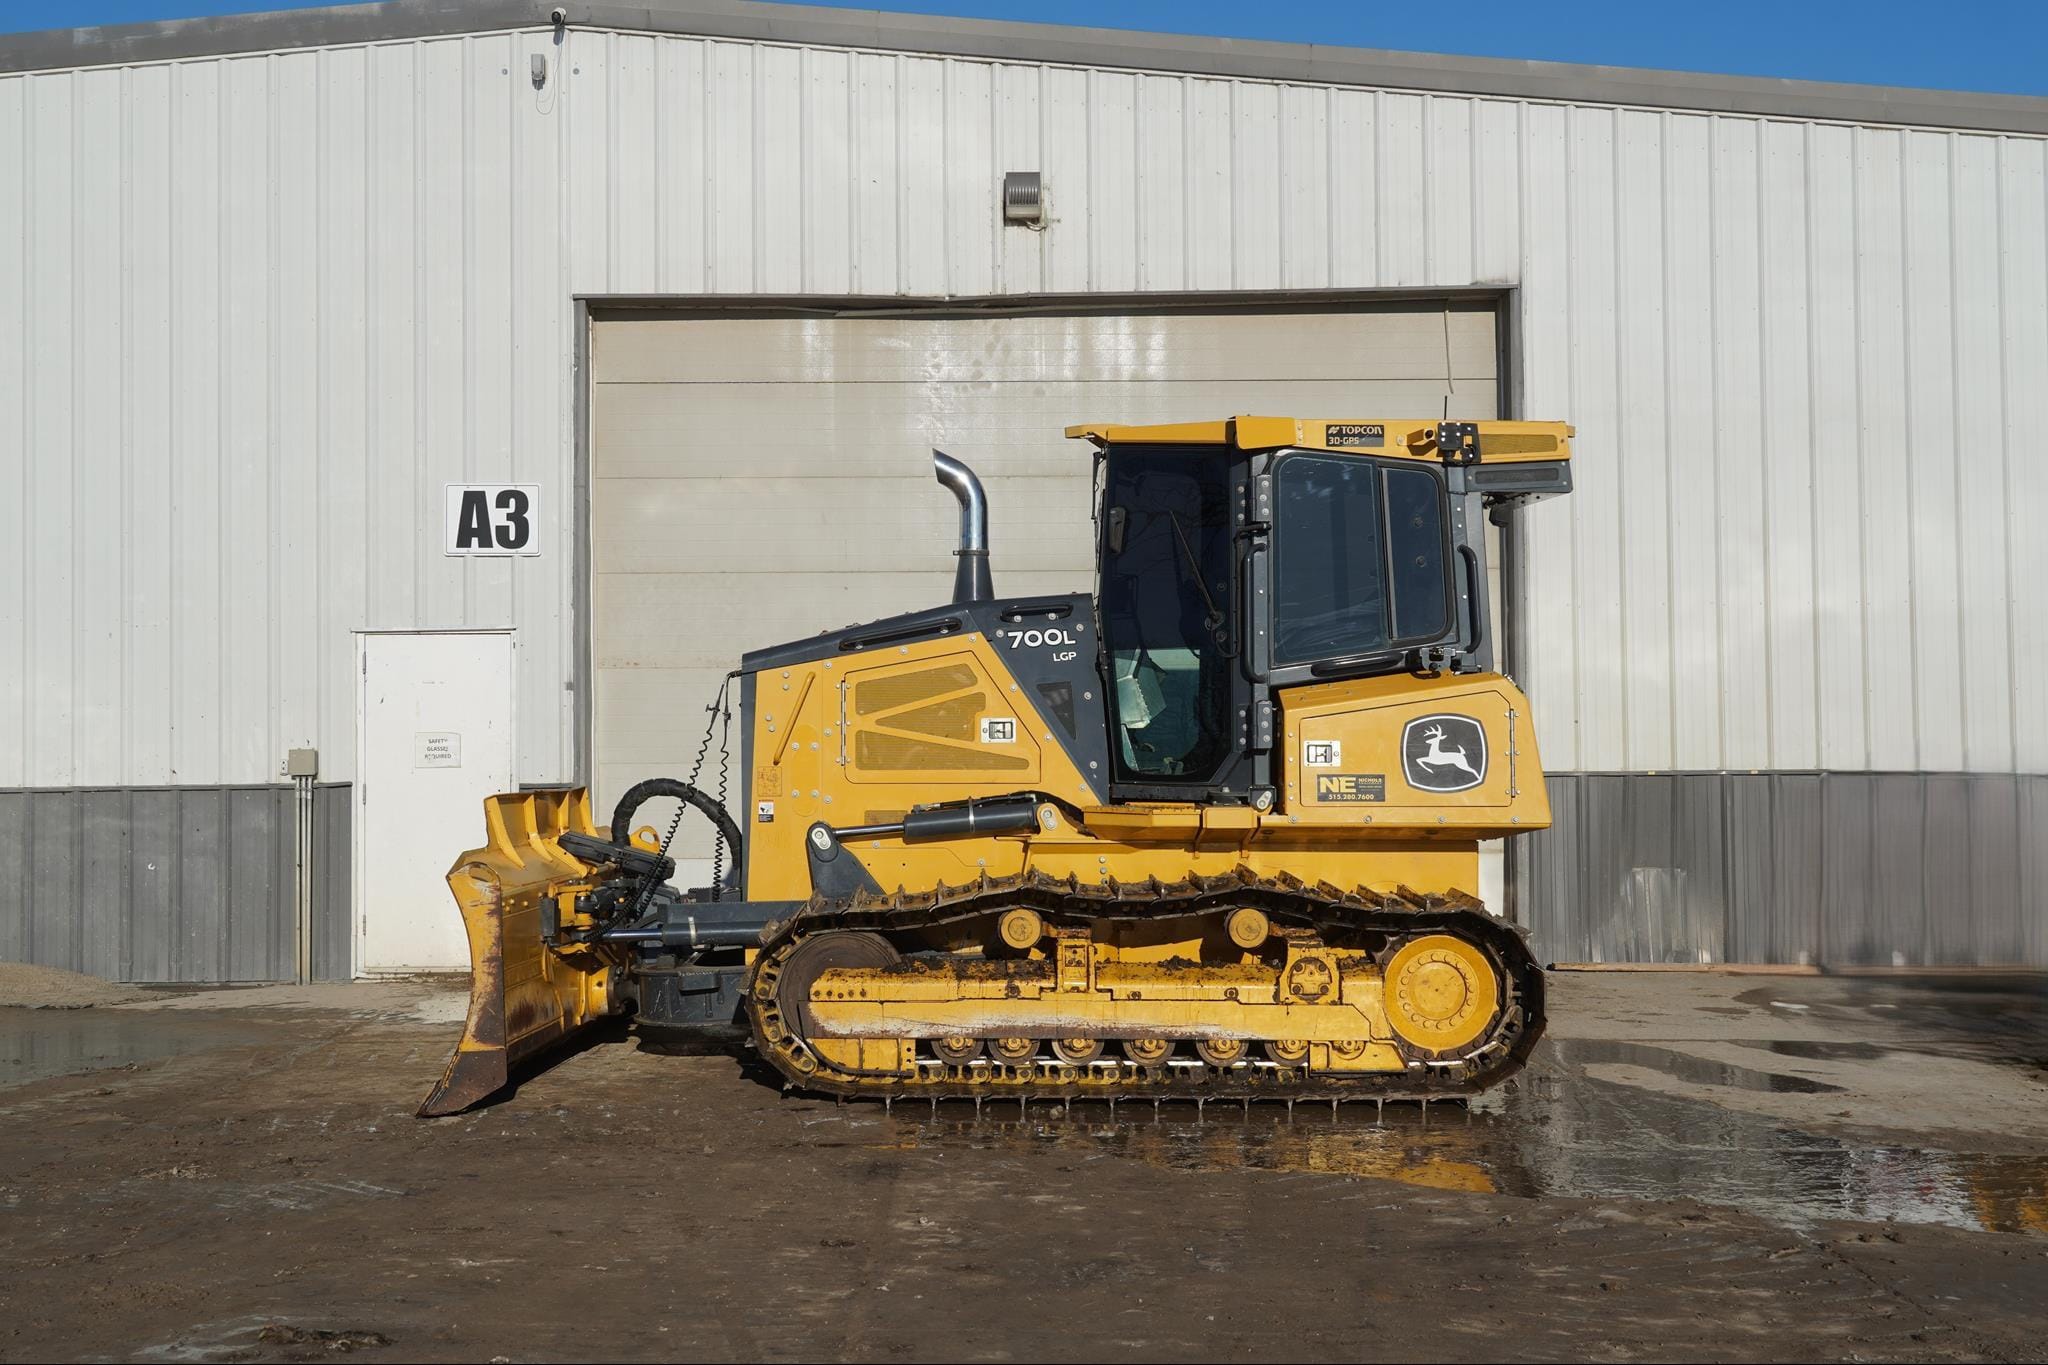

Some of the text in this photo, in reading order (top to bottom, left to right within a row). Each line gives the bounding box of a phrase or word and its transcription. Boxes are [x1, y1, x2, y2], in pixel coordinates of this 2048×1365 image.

[1341, 426, 1382, 435] TOPCON
[1328, 436, 1360, 445] 3D-GPS
[455, 489, 530, 550] A3
[1007, 628, 1076, 649] 700L
[1053, 651, 1077, 662] LGP
[1320, 776, 1357, 793] NE
